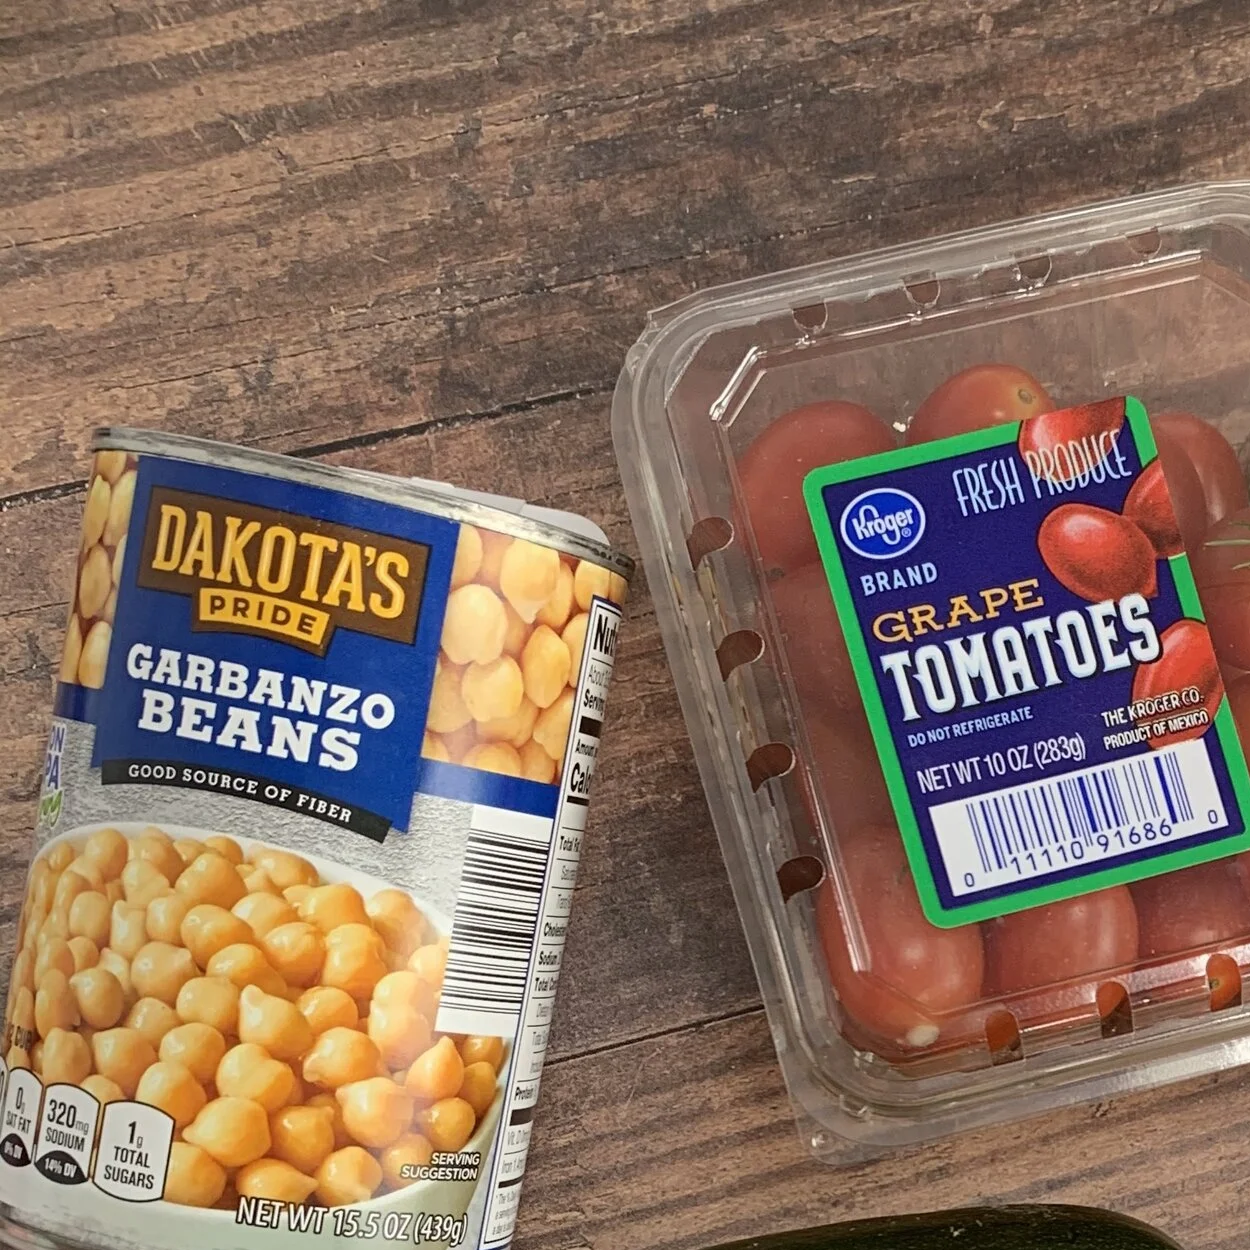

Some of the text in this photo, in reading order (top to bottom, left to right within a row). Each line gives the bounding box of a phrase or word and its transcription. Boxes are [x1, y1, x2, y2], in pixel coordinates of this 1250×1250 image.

[952, 428, 1132, 518] FRESH PRODUCE
[151, 504, 412, 619] DAKOTA'S
[860, 562, 939, 597] BRAND
[208, 594, 318, 636] PRIDE
[872, 579, 1045, 644] GRAPE
[879, 593, 1162, 722] TOMATOES
[126, 643, 396, 730] GARBANZO
[907, 706, 1034, 748] DO NOT REFRIGERATE
[1101, 688, 1205, 730] THE KROGER CO.
[1103, 709, 1209, 751] PRODUCT OF MEXICO
[138, 690, 360, 773] BEANS
[916, 732, 1088, 795] NET WT 10 OZ (283g)
[128, 763, 353, 825] GOOD SOURCE OF FIBER
[964, 809, 1218, 888] 0 11110 91686 0
[17, 1117, 32, 1134] FAT
[47, 1099, 90, 1136] 320mg
[128, 1121, 144, 1148] 1g
[45, 1127, 86, 1152] SODIUM
[114, 1146, 151, 1169] TOTAL
[431, 1152, 481, 1167] SERVING
[63, 1163, 78, 1179] DV
[104, 1164, 155, 1190] SUGARS
[401, 1165, 479, 1182] SUGGESTION
[236, 1197, 284, 1229] NET
[288, 1202, 328, 1234] WT
[333, 1208, 382, 1239] 15.5
[383, 1213, 413, 1241] OZ
[413, 1214, 468, 1247] (439g)
